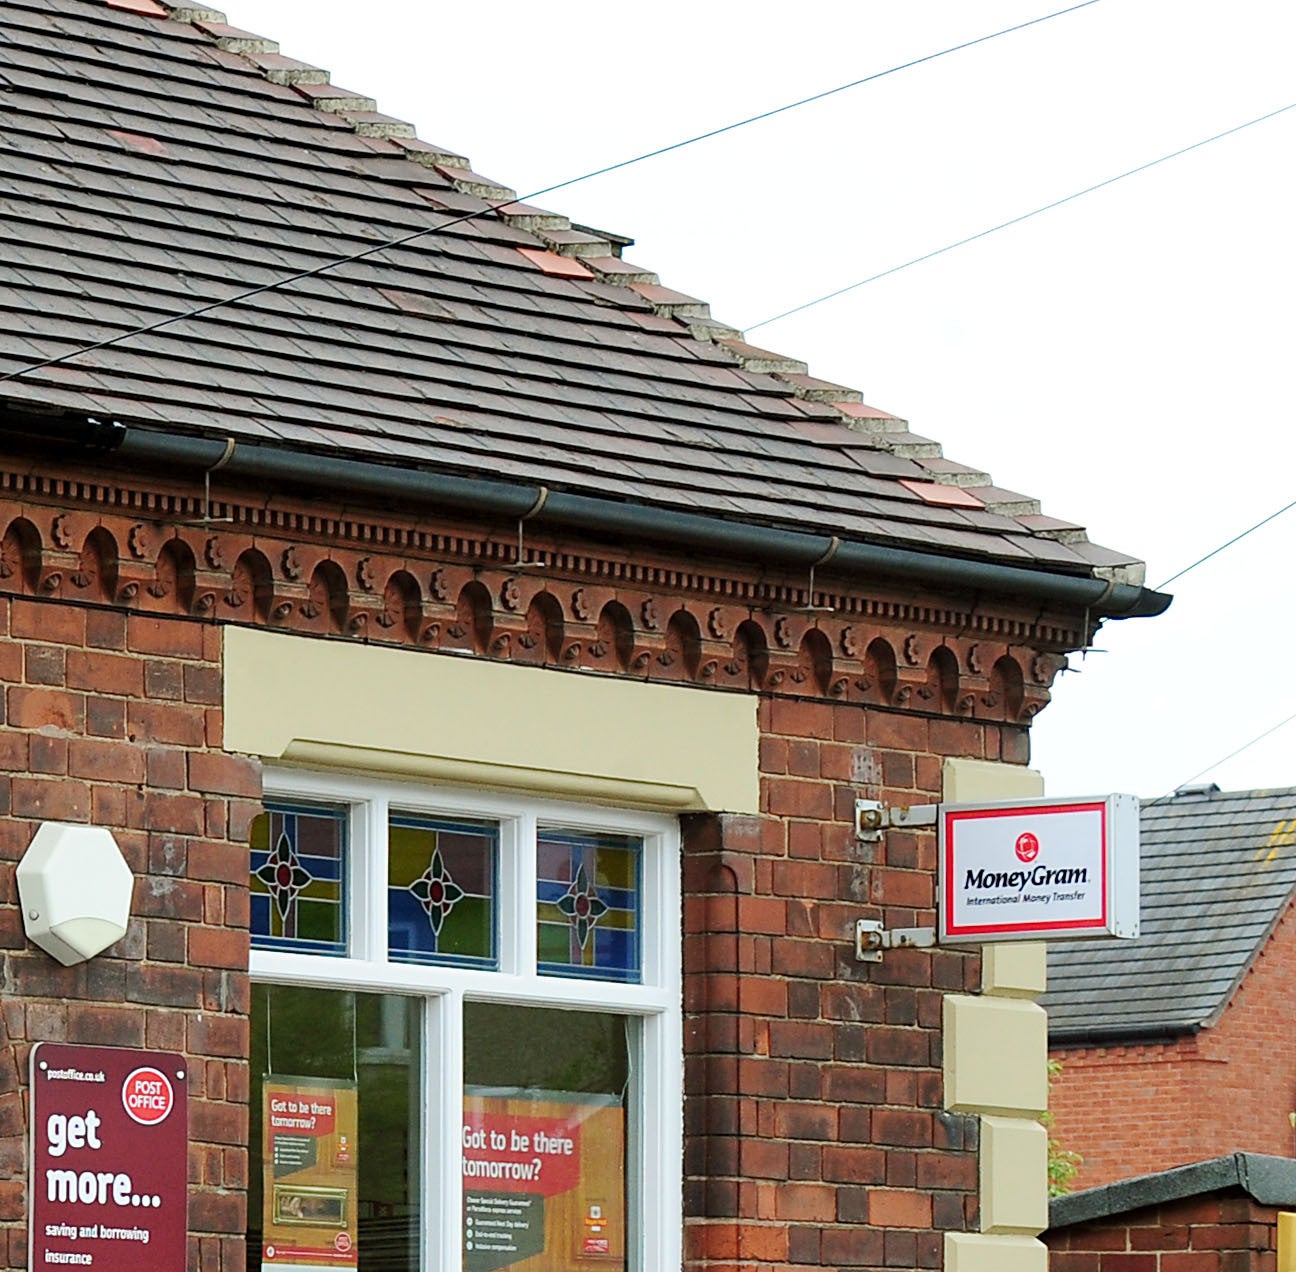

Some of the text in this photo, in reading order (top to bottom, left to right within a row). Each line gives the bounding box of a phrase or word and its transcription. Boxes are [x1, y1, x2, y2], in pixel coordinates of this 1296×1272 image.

[964, 865, 1087, 892] MoneyGram
[966, 891, 1085, 906] International Money Transfer
[47, 1069, 105, 1082] postoffice.co.uk
[135, 1081, 163, 1094] POST
[128, 1095, 166, 1110] OFFICE
[271, 1099, 332, 1116] Got to be there
[271, 1115, 316, 1130] tomorrow?
[47, 1110, 102, 1157] get
[463, 1126, 573, 1155] Got to be there
[463, 1156, 542, 1181] tomorrow?
[46, 1169, 161, 1208] more...
[45, 1222, 149, 1243] saving and borrowing
[45, 1249, 92, 1265] insurance
